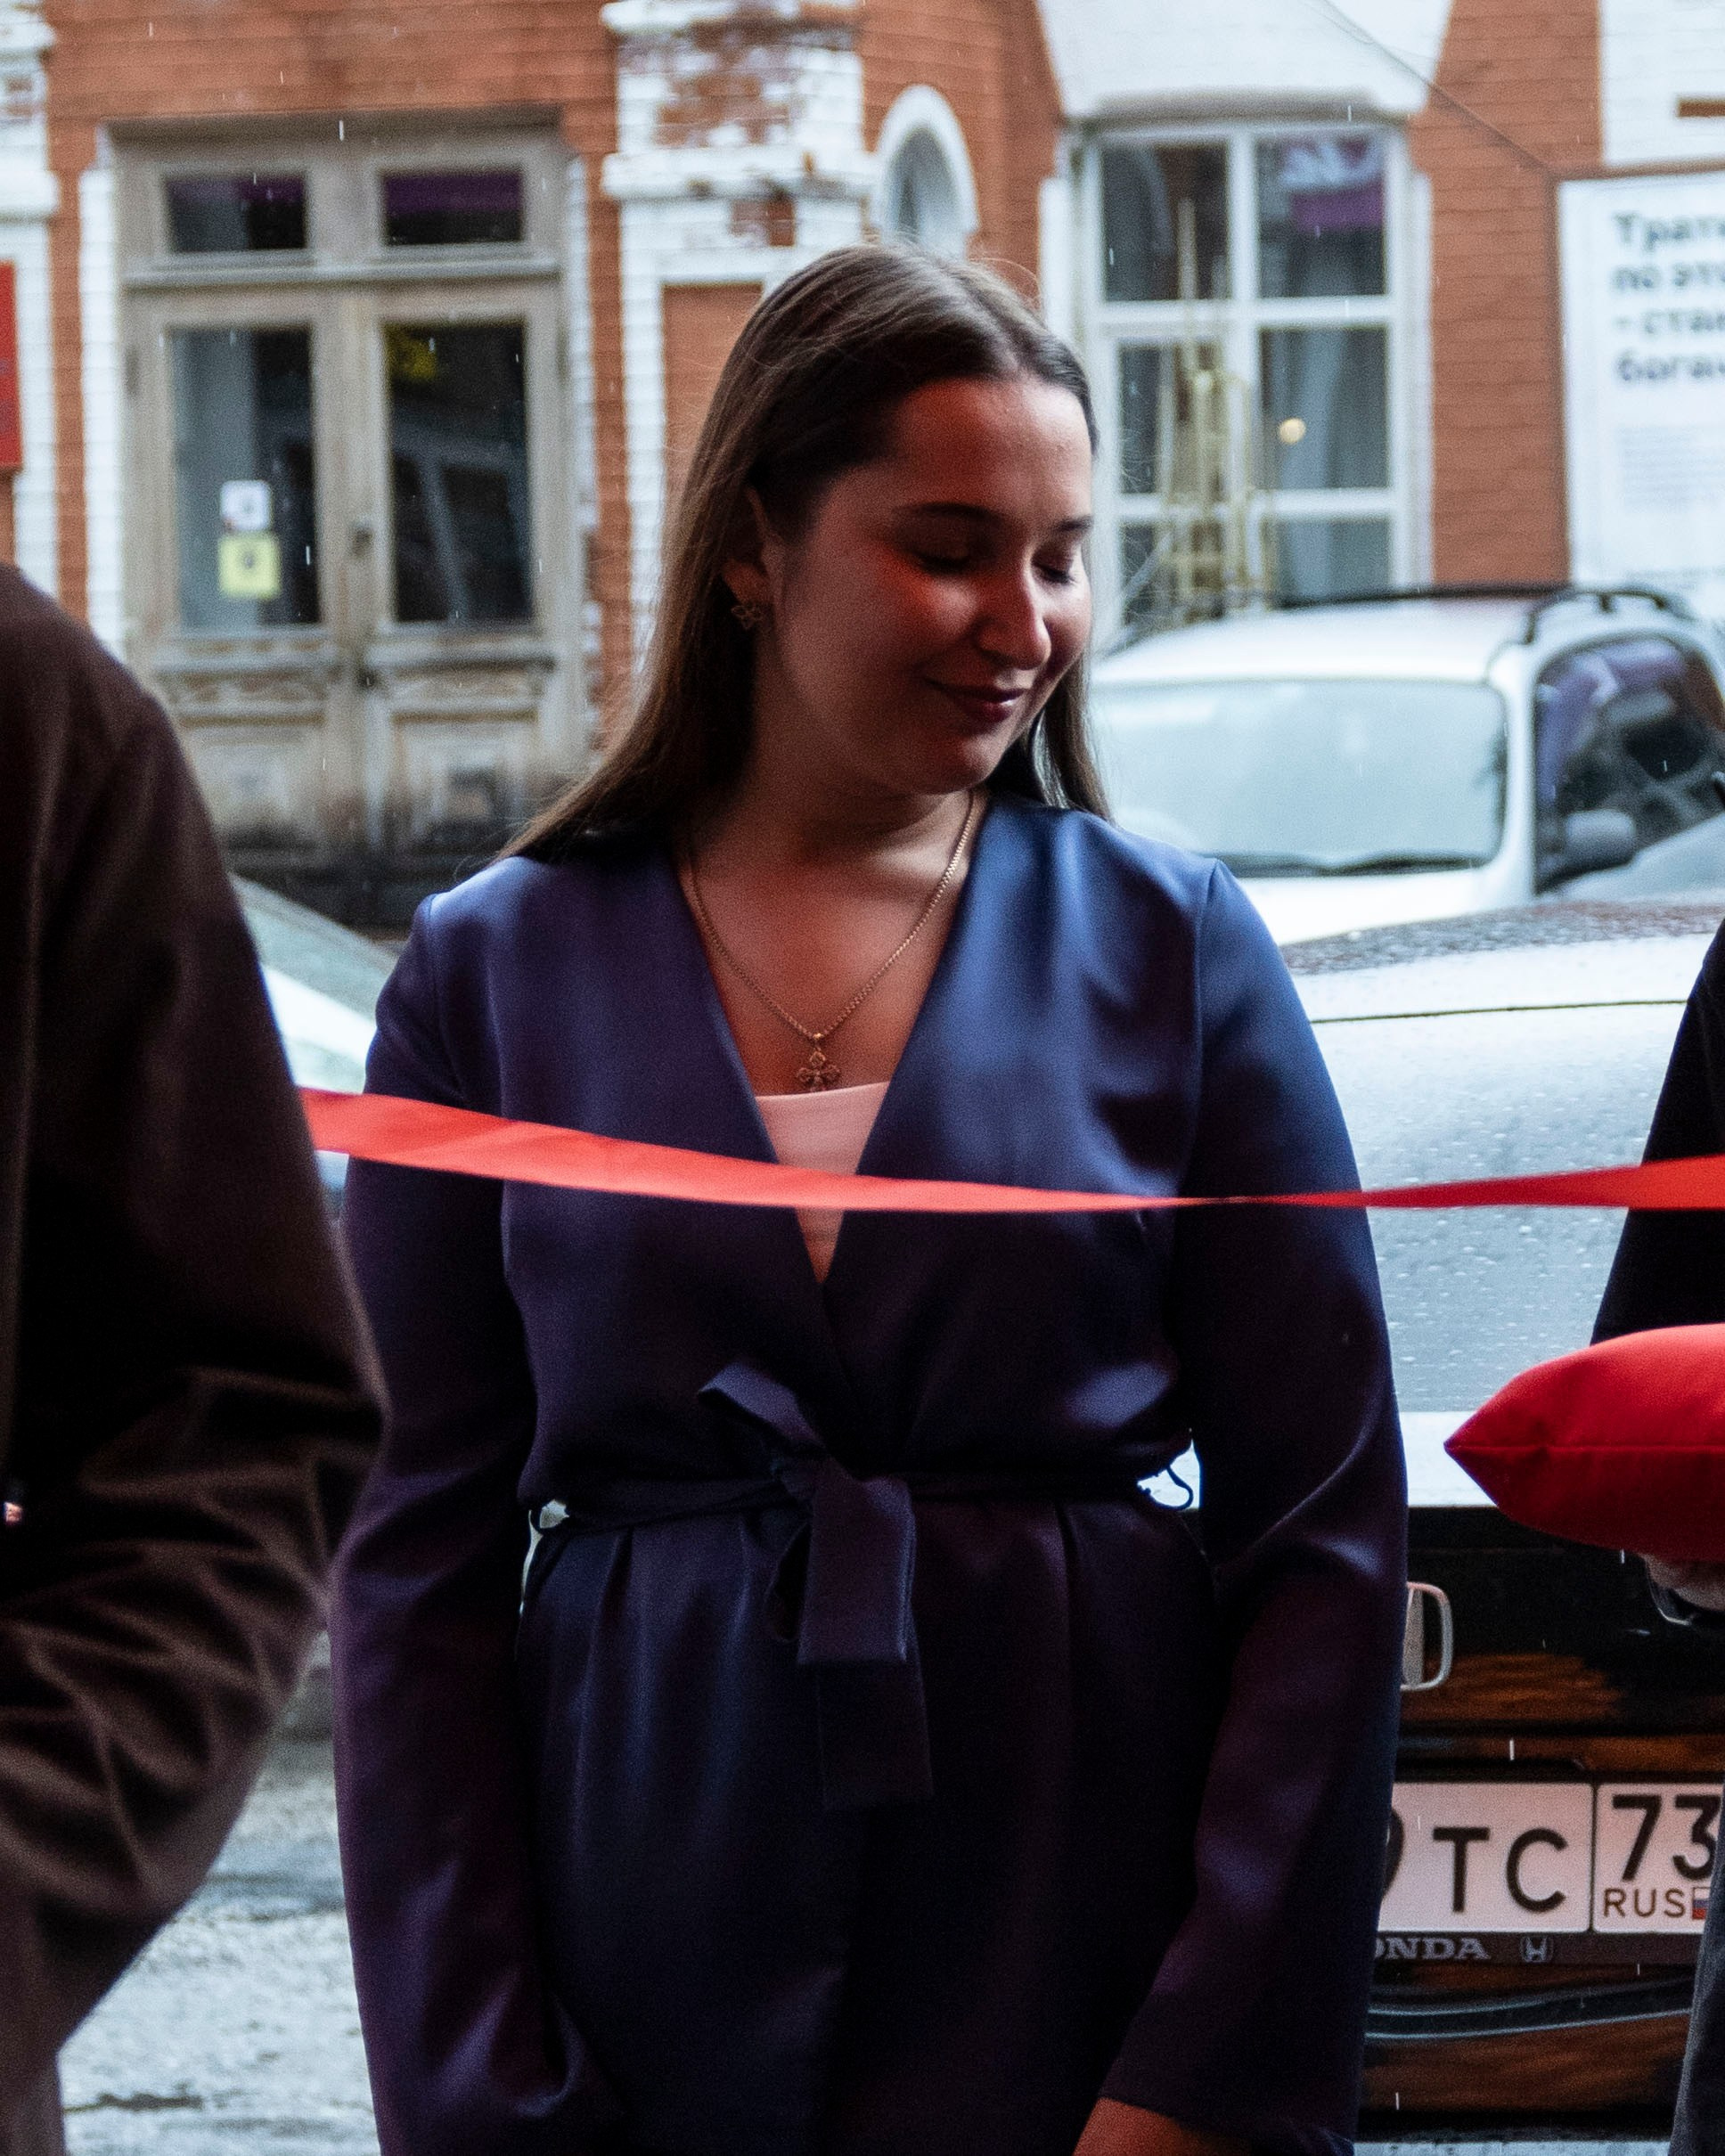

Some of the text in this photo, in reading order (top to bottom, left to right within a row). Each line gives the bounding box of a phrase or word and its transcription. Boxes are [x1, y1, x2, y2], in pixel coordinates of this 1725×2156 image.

[1671, 262, 1725, 290] эт
[1613, 1794, 1721, 1882] 73
[1604, 1888, 1686, 1918] RUS
